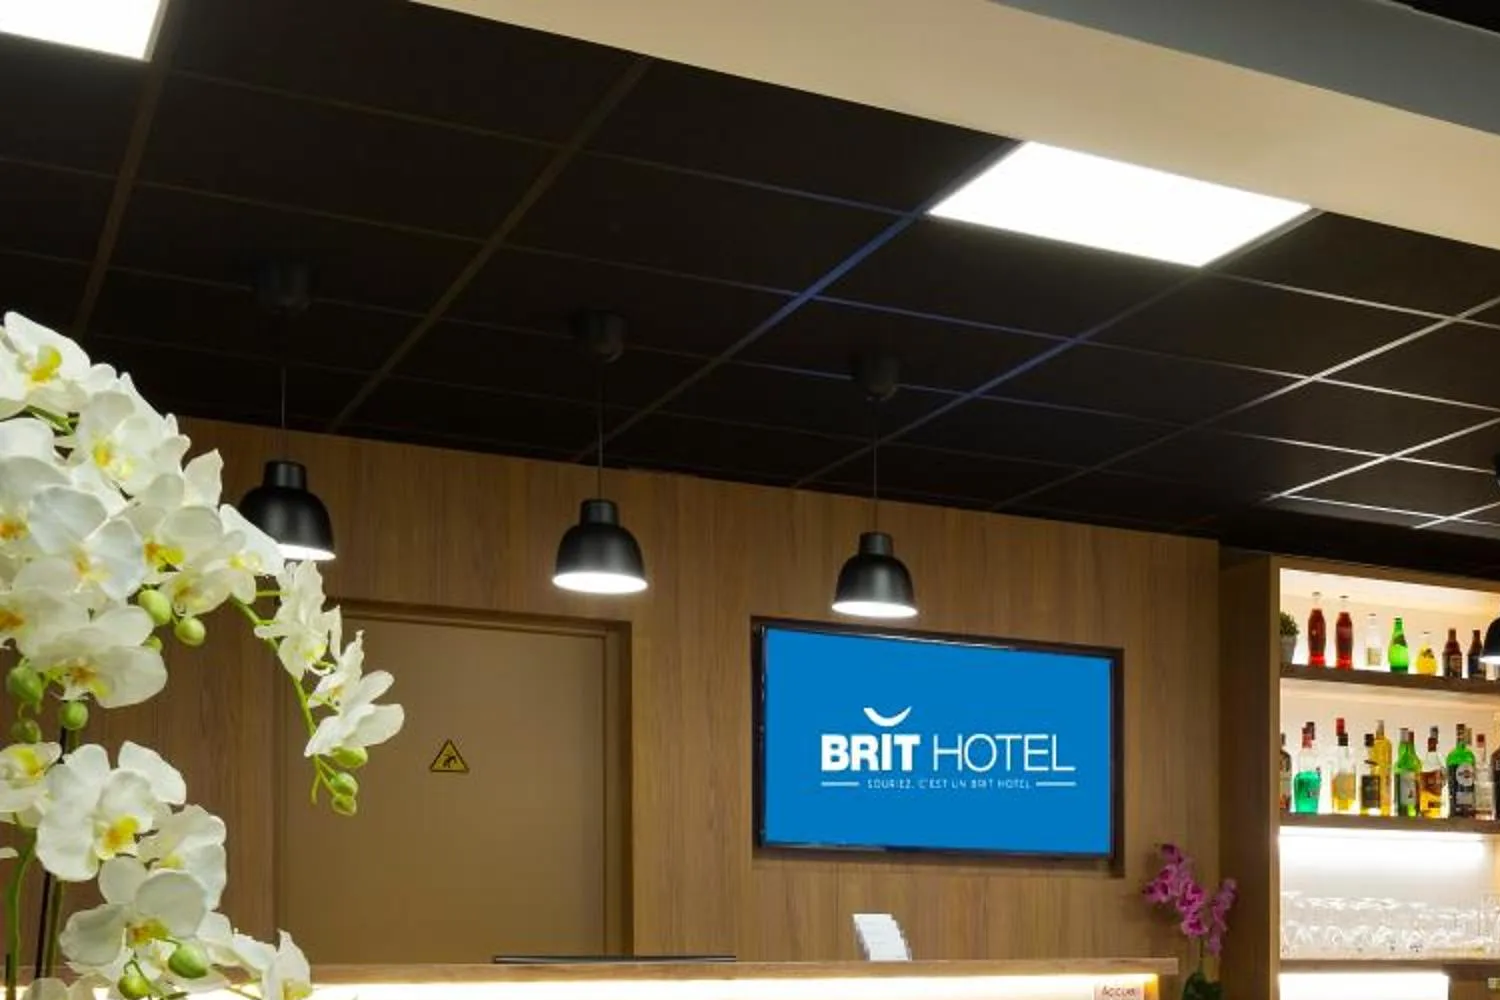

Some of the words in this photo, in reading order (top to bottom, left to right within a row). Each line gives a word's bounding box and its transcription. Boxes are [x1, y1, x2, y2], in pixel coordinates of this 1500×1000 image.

[821, 734, 921, 772] BRIT
[933, 734, 1076, 772] HOTEL
[997, 778, 1031, 789] HOTEL
